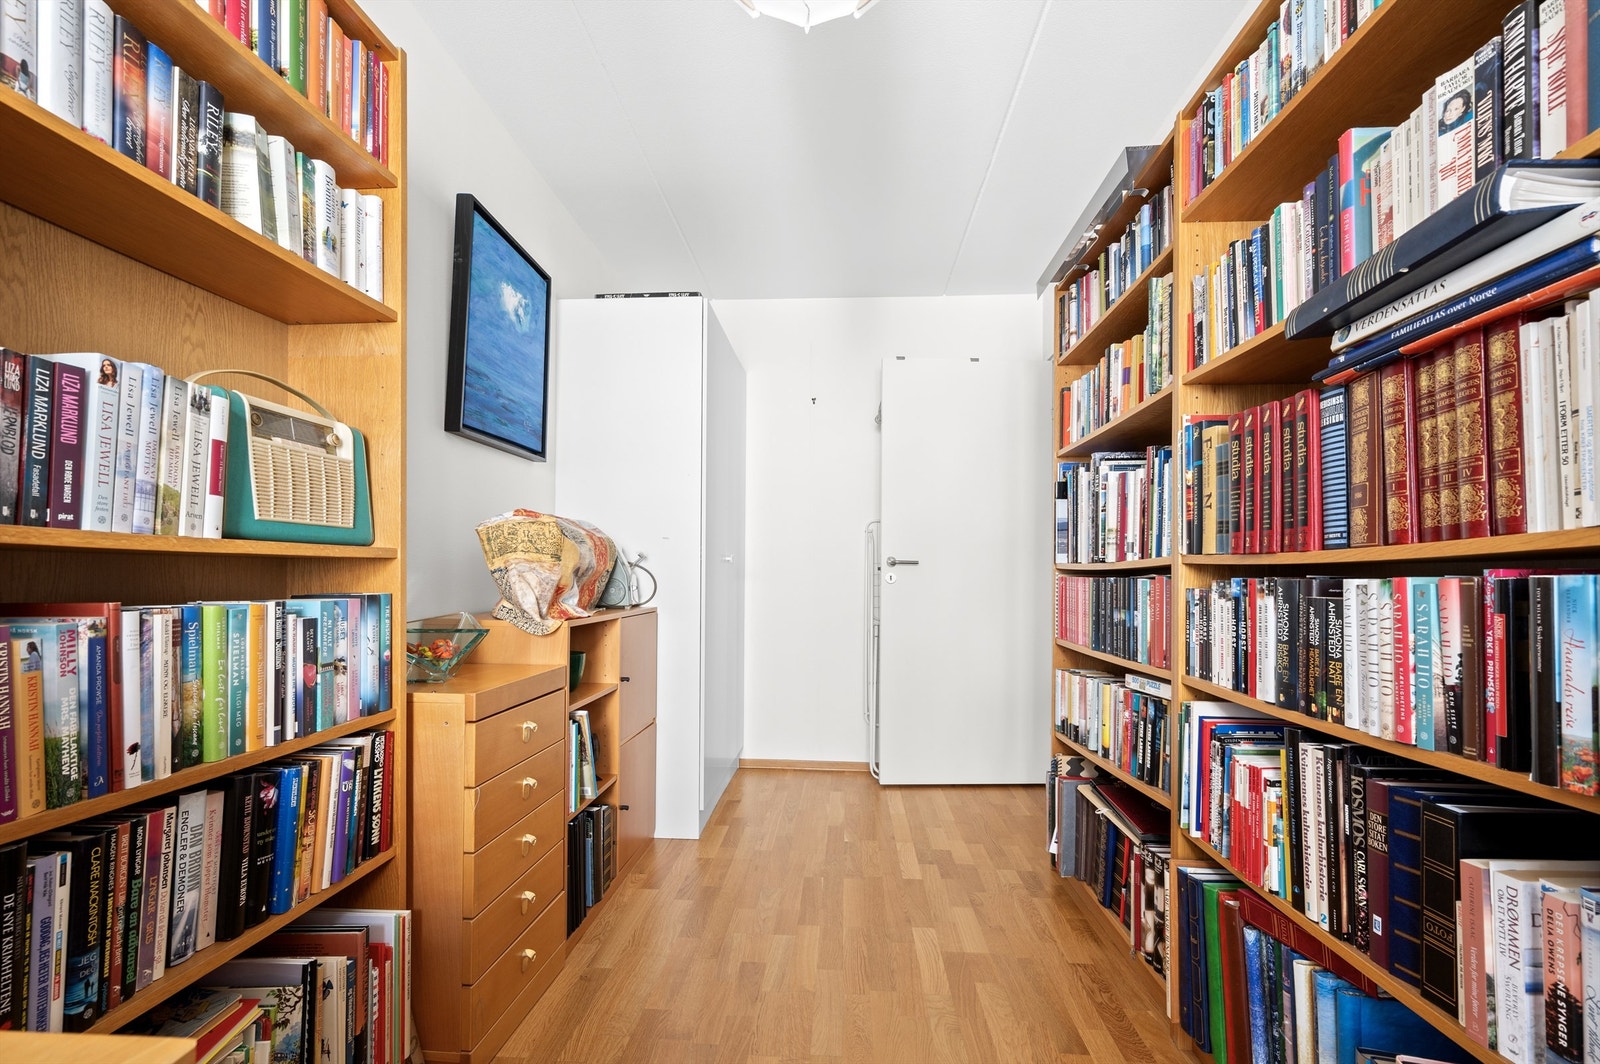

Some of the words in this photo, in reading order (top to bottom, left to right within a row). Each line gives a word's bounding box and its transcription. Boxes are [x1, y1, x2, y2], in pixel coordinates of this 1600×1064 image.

[88, 6, 106, 74] RILEY
[1503, 10, 1526, 67] EMMA
[123, 31, 141, 105] RILEY
[1503, 55, 1526, 117] HARTE
[205, 101, 220, 149] RILEY
[1475, 89, 1494, 140] VILJENS
[1476, 132, 1495, 169] MAKT
[325, 174, 335, 223] Bomann
[1353, 279, 1449, 334] VERDENSATLAS
[1390, 309, 1447, 340] FAMILIEATLAS
[1446, 303, 1468, 316] over
[1467, 286, 1498, 308] Norge
[35, 367, 50, 393] LIZA
[61, 372, 80, 392] LIZA
[127, 376, 137, 399] Lisa
[150, 376, 160, 399] Lisa
[173, 385, 183, 408] Lisa
[31, 395, 49, 460] MARKLUND
[59, 393, 79, 445] MARKLUND
[100, 401, 114, 431] LISA
[124, 402, 136, 437] Jewell
[148, 402, 159, 435] Jewell
[171, 410, 182, 442] Jewell
[1559, 404, 1569, 428] FORM
[1585, 405, 1594, 438] SMERTER
[150, 439, 158, 467] DAGEN
[192, 429, 204, 458] LISA
[1245, 435, 1254, 479] studia
[1263, 431, 1272, 476] studia
[1283, 427, 1292, 473] studia
[1297, 420, 1308, 469] studia
[1560, 429, 1569, 455] ETTER
[64, 460, 73, 471] DEN
[96, 435, 112, 489] JEWELL
[1231, 439, 1241, 481] studia
[1461, 467, 1473, 477] IV
[1497, 462, 1506, 472] V
[1561, 455, 1570, 466] 50
[31, 464, 42, 498] Fasadefall
[62, 484, 72, 504] VARGEN
[189, 460, 202, 509] JEWELL
[1442, 472, 1451, 483] III
[185, 510, 203, 520] Arven
[327, 619, 333, 630] NI
[1282, 602, 1290, 642] SIMONA
[1328, 600, 1336, 659] AHRNSTEDT
[1334, 618, 1343, 659] SIMONA
[1358, 609, 1367, 647] SARAH
[1367, 592, 1379, 654] SARAH
[1379, 601, 1393, 662] SARAH
[1416, 603, 1429, 658] SARAH
[59, 629, 68, 678] JOHNSON
[66, 629, 77, 676] MILLY
[185, 622, 200, 676] Spielman
[231, 632, 241, 687] SPIELMAN
[1485, 629, 1494, 659] YRKE:
[26, 675, 39, 702] KRISTIN
[163, 680, 170, 690] OG
[256, 661, 265, 702] Sullivan's
[1328, 660, 1336, 686] NATT
[1335, 661, 1343, 687] BARE
[1486, 659, 1495, 707] PRINSESSE
[68, 687, 77, 710] DEN
[95, 676, 103, 705] PROWSE
[27, 703, 40, 752] HANNAH
[60, 696, 69, 726] MRS.
[256, 703, 265, 729] Island
[1564, 701, 1577, 729] reise
[61, 726, 71, 776] MAYHEW
[69, 711, 79, 782] FABELAKTIGE
[371, 768, 384, 813] LYKKENS
[1299, 747, 1311, 809] Kvinnenes
[1314, 756, 1325, 819] Kvinnenes
[1326, 758, 1334, 804] Ingredienser
[244, 795, 252, 815] KETIL
[1350, 774, 1366, 848] KOSMOS
[1369, 811, 1382, 824] DEN
[134, 826, 144, 846] MONA
[161, 811, 175, 851] Margaret
[179, 810, 190, 852] ENGLER
[187, 823, 204, 849] DAN
[206, 809, 218, 843] Kvinner
[242, 816, 251, 855] BJØRNSTAD
[370, 814, 383, 846] SØNN
[1367, 820, 1387, 835] STORE
[89, 847, 102, 880] CLARE
[133, 847, 143, 876] LYNGAR
[178, 853, 187, 861] &
[1302, 808, 1314, 891] kulturhistorie
[1316, 819, 1329, 904] kulturhistorie
[1355, 851, 1366, 878] CARL
[118, 855, 128, 888] BORGEN
[160, 851, 173, 889] Johansen
[185, 850, 203, 894] BROWN
[240, 857, 250, 878] VILLA
[3, 893, 15, 911] DE
[130, 879, 141, 908] Bare
[146, 875, 158, 915] LYNGAR
[176, 862, 188, 914] DEMONER
[239, 879, 249, 907] EUROPA
[1496, 888, 1505, 905] OM
[2, 914, 14, 937] NYE
[86, 880, 101, 947] MACKINTOSH
[129, 912, 138, 931] en
[1319, 913, 1329, 925] 2
[1497, 905, 1505, 917] ET
[1505, 884, 1521, 972] DRØMMEN
[1545, 907, 1555, 936] DELIA
[1554, 911, 1564, 936] DER
[144, 921, 156, 945] GRIS
[1497, 916, 1506, 941] NYTT
[38, 948, 51, 962] JEG
[78, 952, 97, 968] JEG
[1498, 942, 1507, 958] LIV
[1546, 939, 1556, 975] OWENS
[0, 937, 14, 1016] KRIMHELTENE
[37, 962, 51, 984] HETER
[1555, 938, 1568, 997] KREPSENE
[1503, 974, 1513, 1021] SWERLING
[1511, 983, 1520, 1022] BEVERLY
[1556, 998, 1568, 1049] SYNGER
